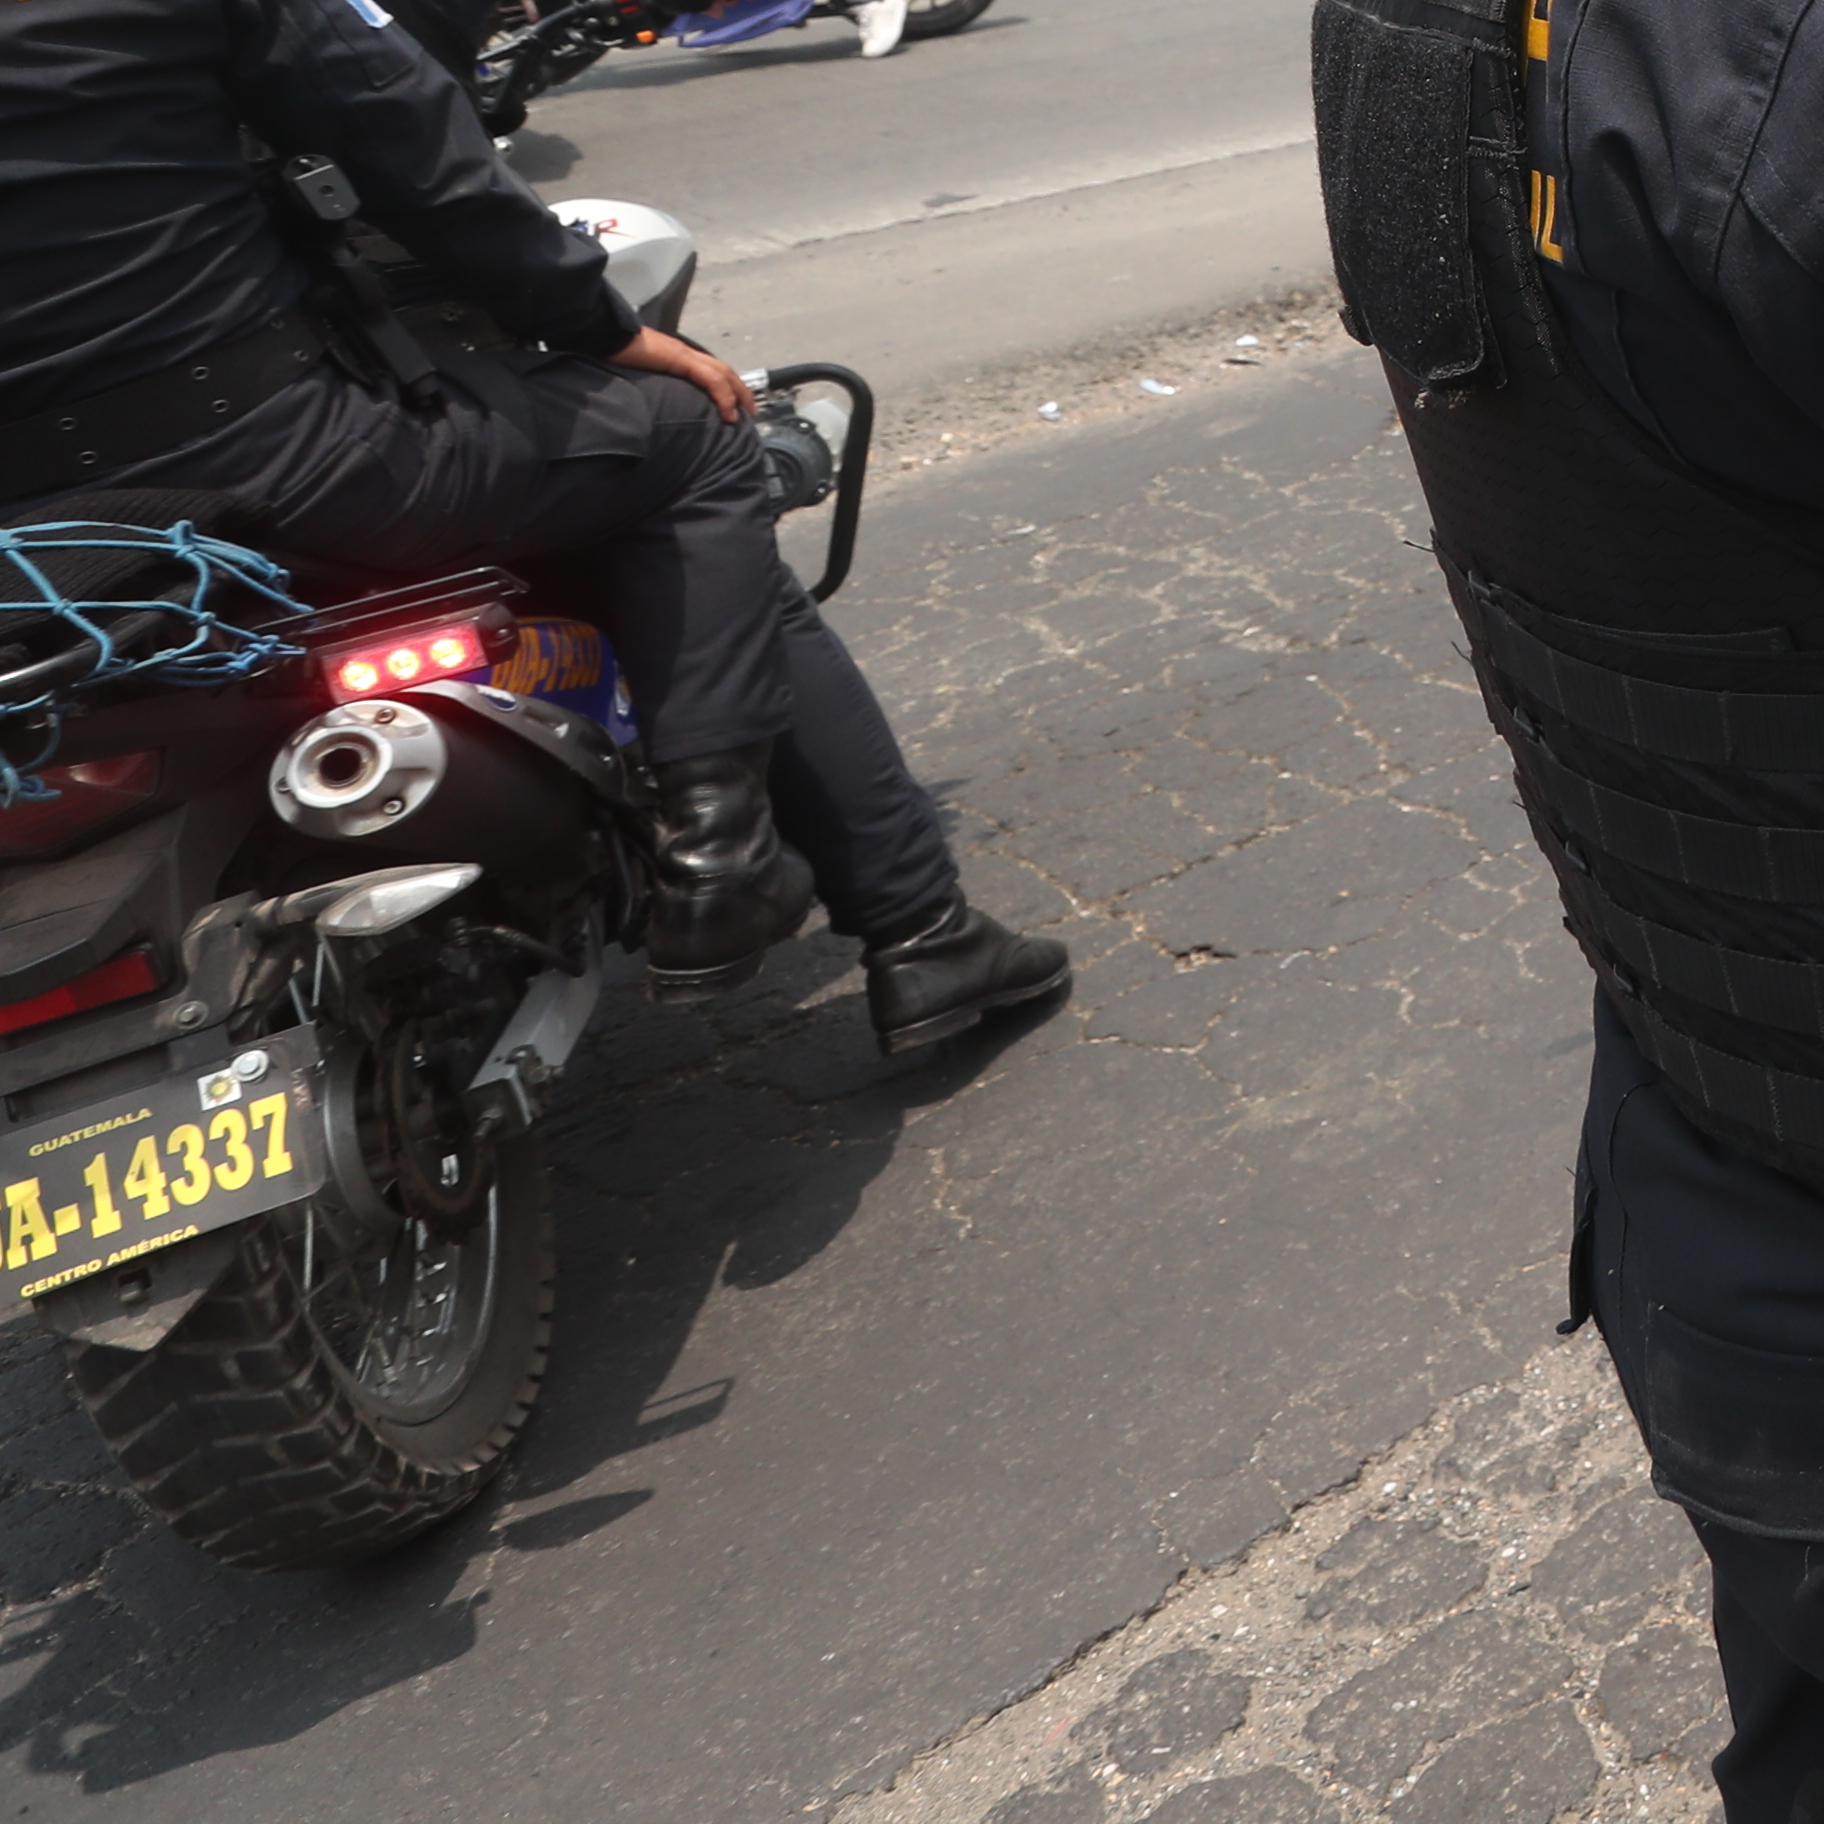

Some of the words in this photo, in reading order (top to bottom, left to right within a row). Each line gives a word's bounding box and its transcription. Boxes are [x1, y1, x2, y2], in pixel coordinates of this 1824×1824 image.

[28, 1107, 153, 1157] GUATEMALA
[0, 1091, 293, 1270] A-14337
[20, 1257, 102, 1298] CENTRO
[106, 1224, 200, 1267] AMÉRICA
